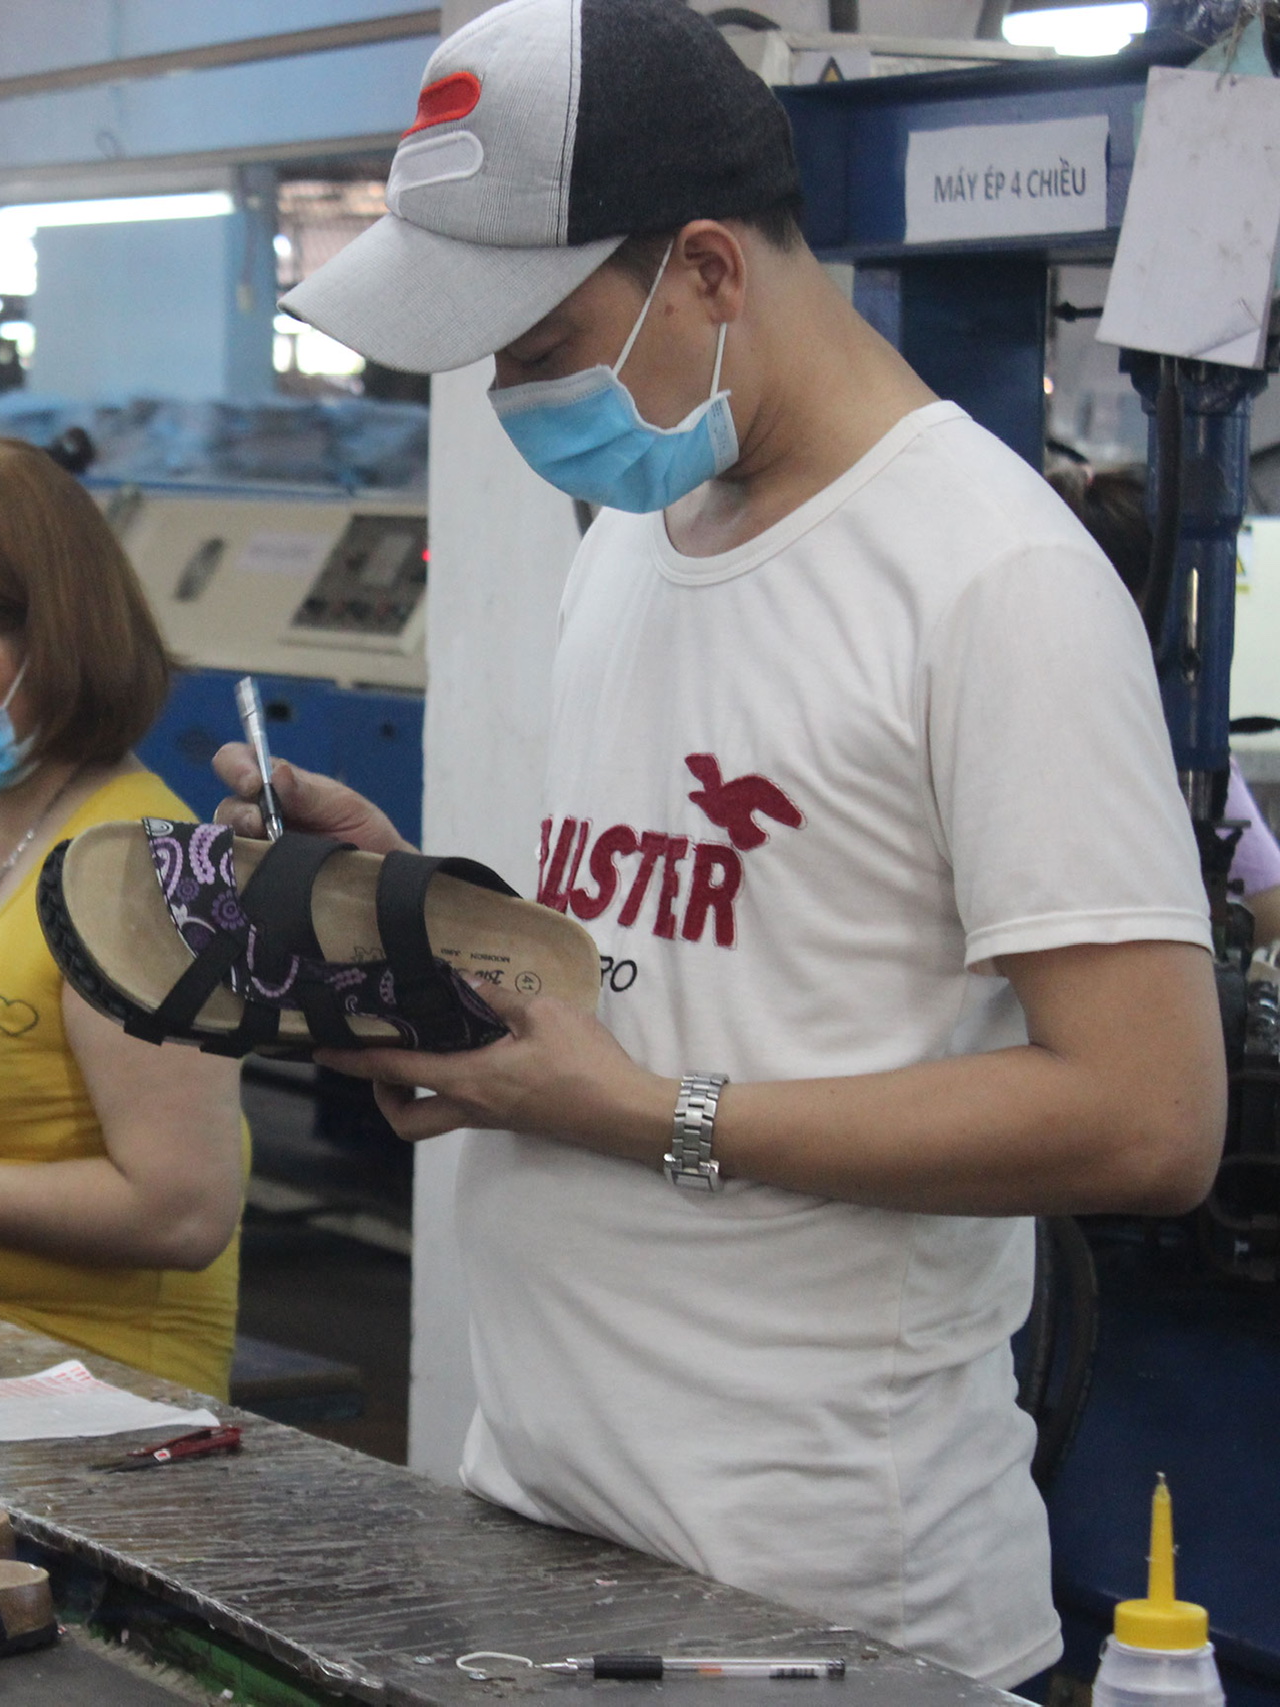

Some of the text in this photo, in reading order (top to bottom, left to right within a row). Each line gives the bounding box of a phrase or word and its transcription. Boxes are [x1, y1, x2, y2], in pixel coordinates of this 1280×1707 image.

[934, 156, 1086, 202] MÁY ÉP 4 CHIỀU
